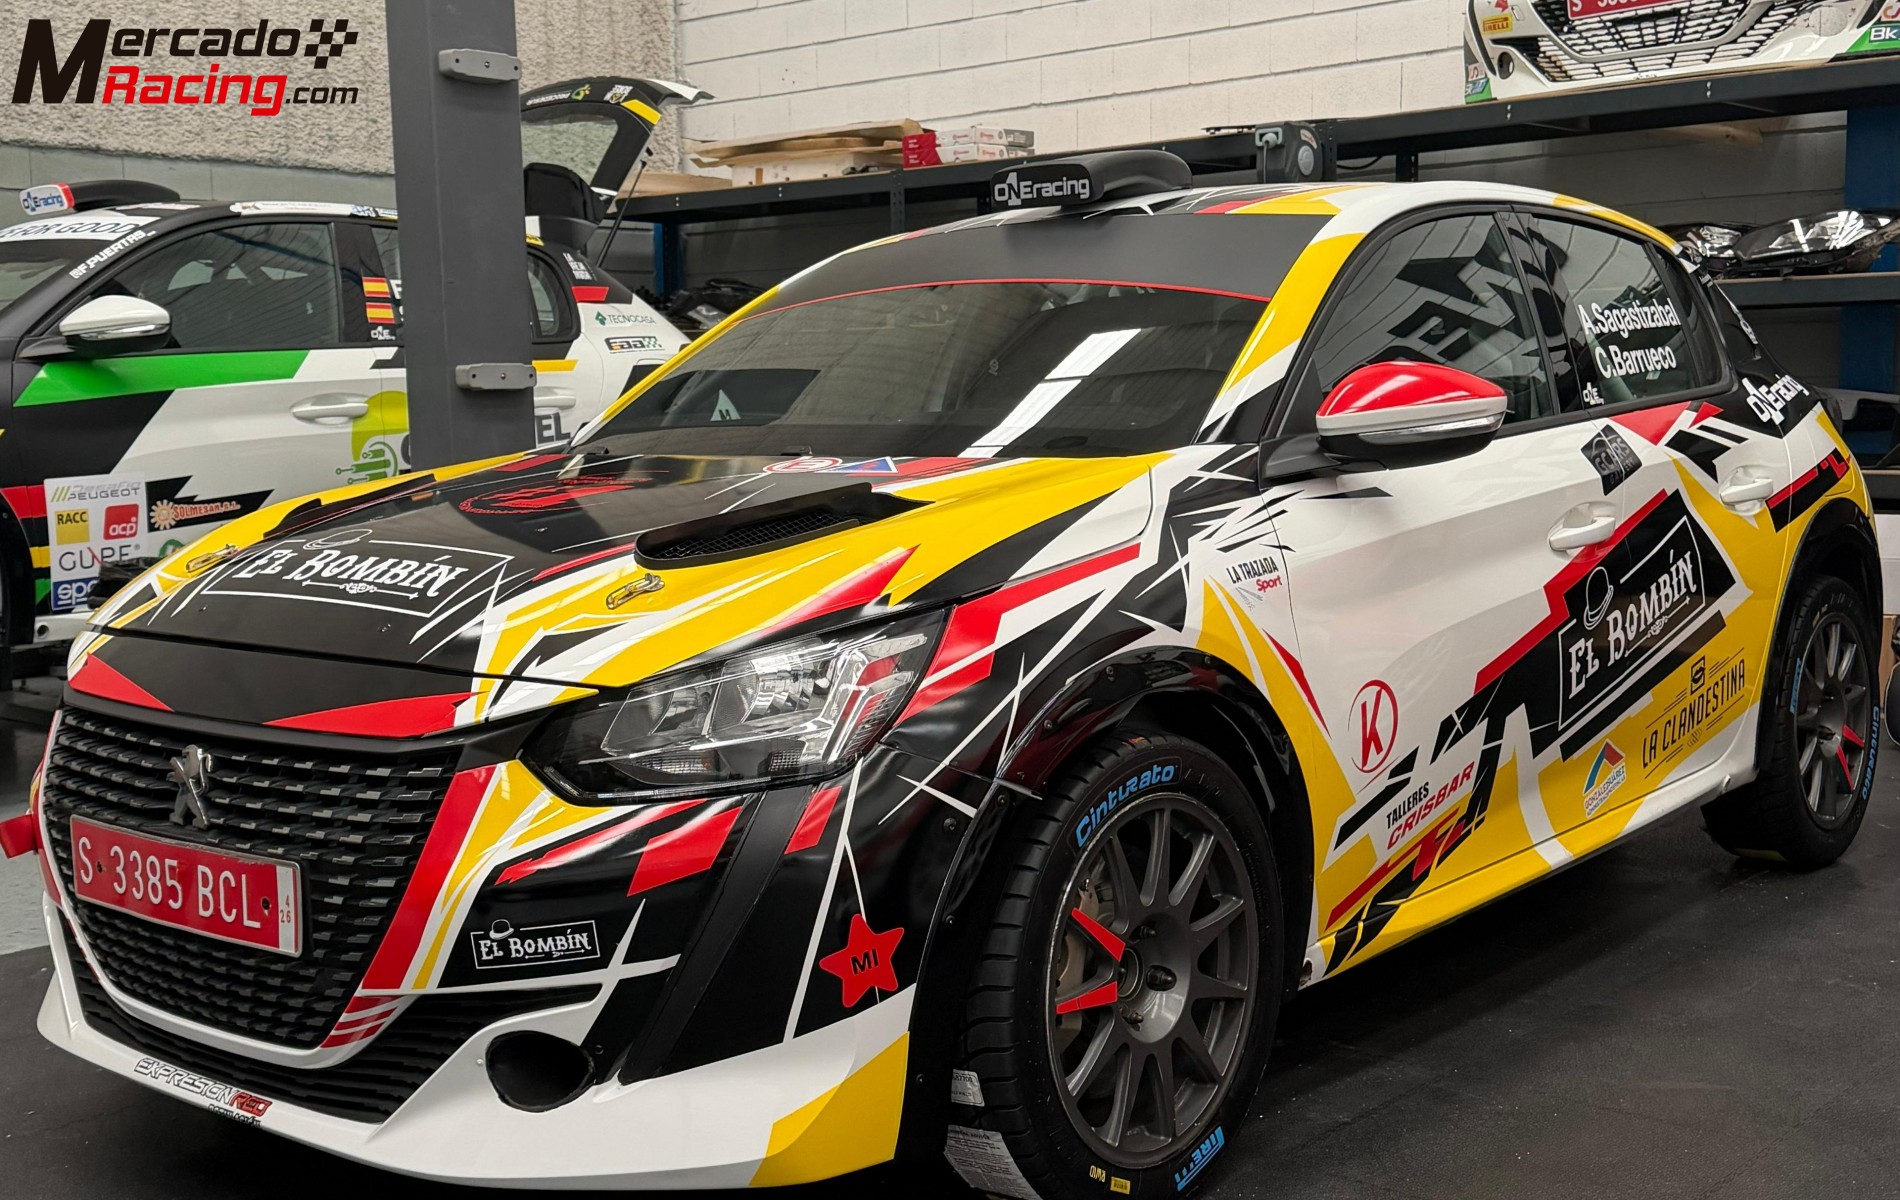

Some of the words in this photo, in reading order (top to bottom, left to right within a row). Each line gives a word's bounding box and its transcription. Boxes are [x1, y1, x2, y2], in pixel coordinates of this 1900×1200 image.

[608, 314, 656, 324] TECNOCASA
[1578, 298, 1681, 339] A.Sagastizabal
[1595, 345, 1677, 379] C.Barrueco
[68, 488, 140, 500] PEUGEOT
[57, 511, 87, 525] RACC
[109, 517, 137, 537] acp
[232, 549, 298, 578] EL
[283, 550, 469, 597] BOMBÍN
[1226, 566, 1242, 584] LA
[1238, 556, 1279, 580] TRAZADA
[1256, 575, 1283, 592] Sport
[1568, 637, 1600, 699] EL
[1606, 549, 1697, 667] BOMBÍN
[1642, 729, 1659, 769] LA
[1661, 658, 1745, 752] CLANDESTINA
[1386, 781, 1429, 829] TALLERES
[1387, 761, 1475, 850] CRISBAR
[78, 837, 93, 884] S
[110, 846, 183, 909] 3385
[197, 865, 261, 929] BCL
[285, 895, 290, 908] 4
[280, 909, 292, 924] 26
[478, 940, 504, 960] EL
[508, 929, 592, 958] BOMBÍN
[851, 948, 879, 975] MI
